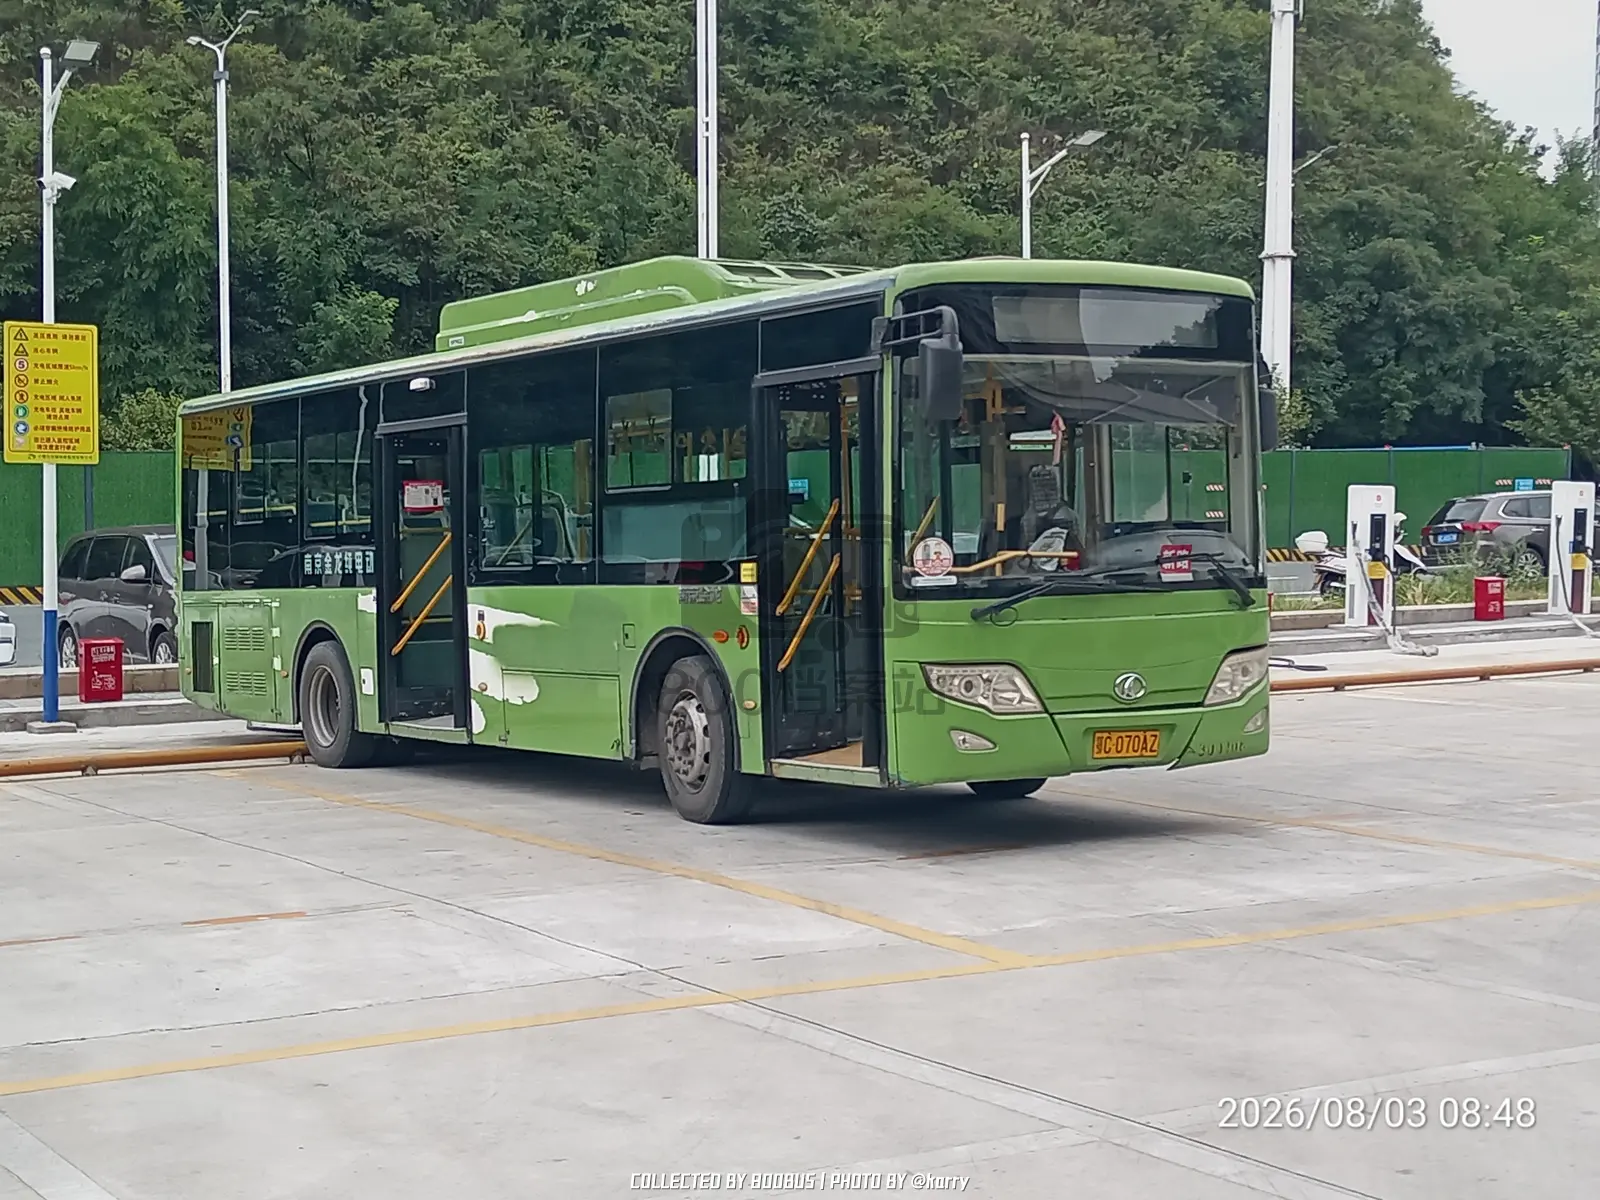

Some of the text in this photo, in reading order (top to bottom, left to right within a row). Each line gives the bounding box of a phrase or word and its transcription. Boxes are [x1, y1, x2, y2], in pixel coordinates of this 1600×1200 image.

[18, 360, 25, 369] 5
[304, 551, 375, 575] 南京金龙纯电动
